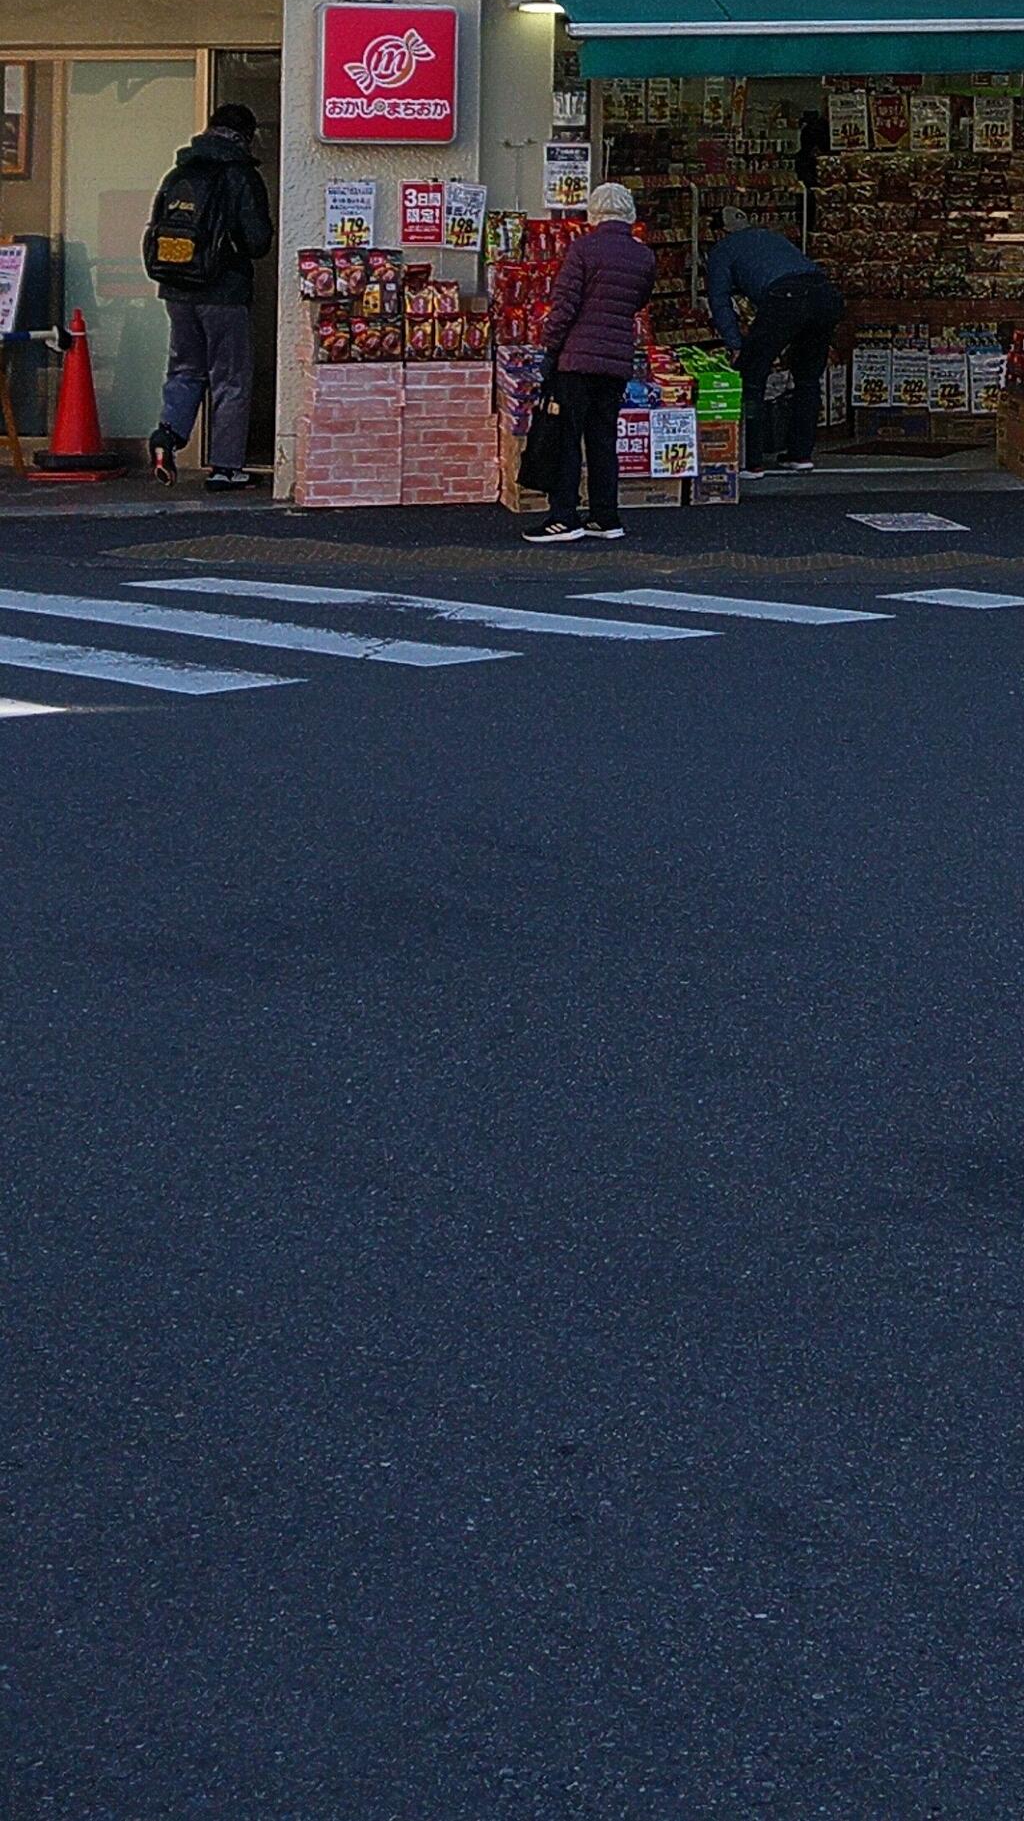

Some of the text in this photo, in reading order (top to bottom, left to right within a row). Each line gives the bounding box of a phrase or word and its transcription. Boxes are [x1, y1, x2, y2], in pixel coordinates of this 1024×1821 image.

[325, 97, 451, 120] おかしのまちおか
[339, 216, 365, 232] 179
[450, 217, 475, 232] 198
[664, 443, 688, 461] 157
